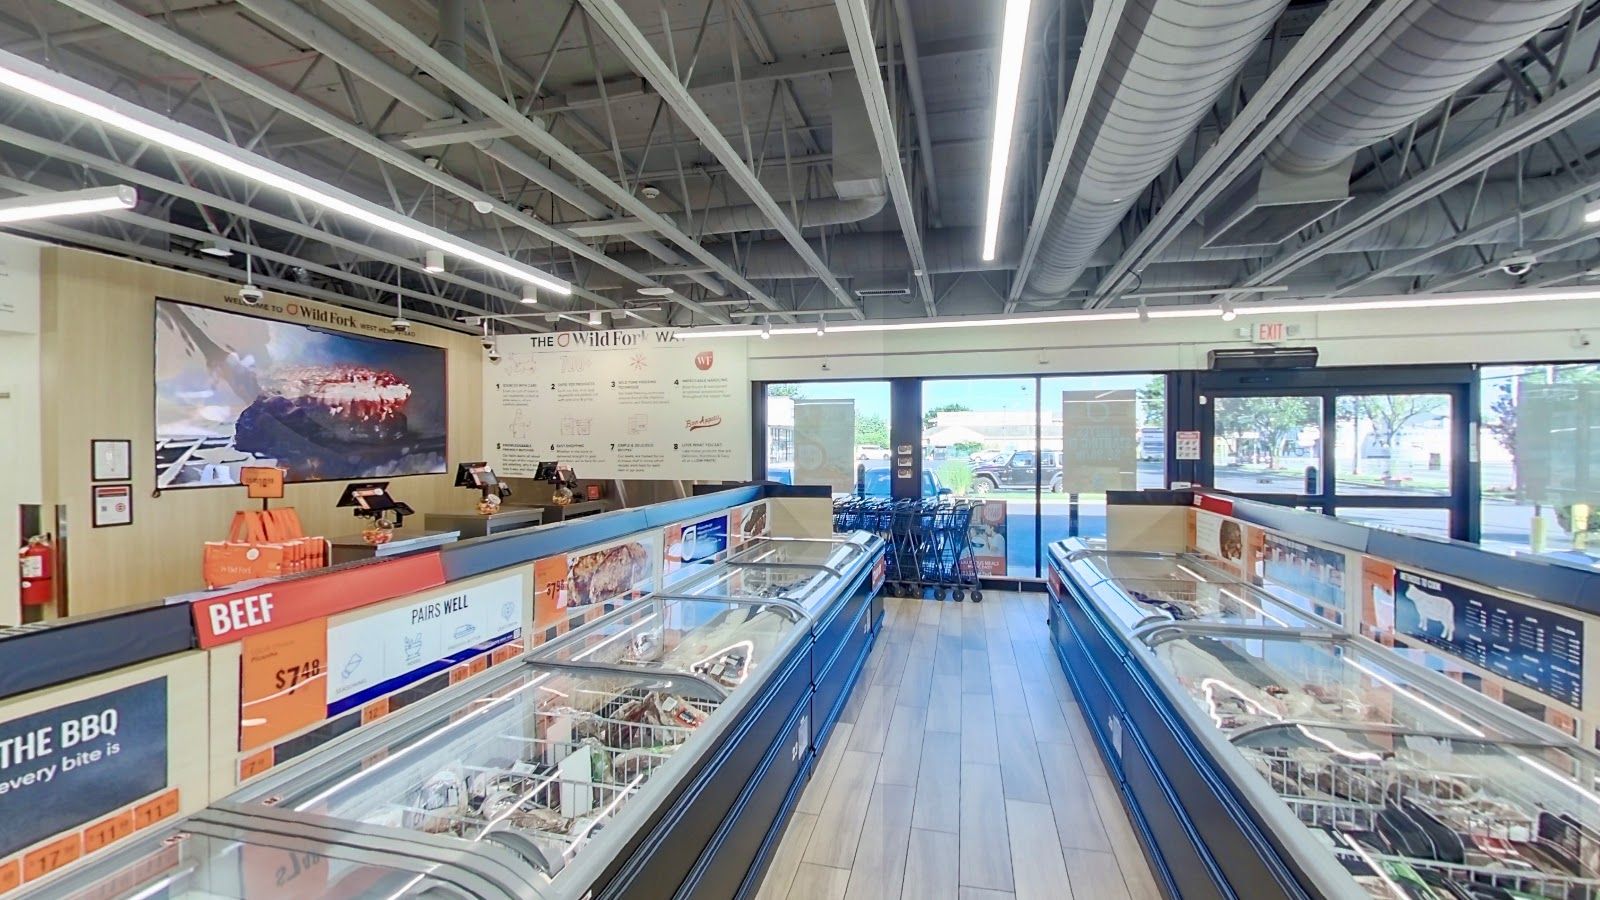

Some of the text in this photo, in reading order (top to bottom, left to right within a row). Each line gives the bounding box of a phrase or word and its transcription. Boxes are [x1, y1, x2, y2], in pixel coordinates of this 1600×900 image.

[272, 305, 283, 314] TO
[300, 305, 357, 328] Wild Fork
[360, 323, 416, 338] WEST HEMPEAD
[530, 329, 686, 348] THE Wild Fork WA
[1259, 323, 1283, 340] EXIT
[697, 355, 713, 366] WF
[208, 592, 274, 637] BEEF
[411, 594, 469, 625] PAIRS WELL
[0, 708, 119, 770] THE BBQ
[0, 741, 121, 795] every bite is
